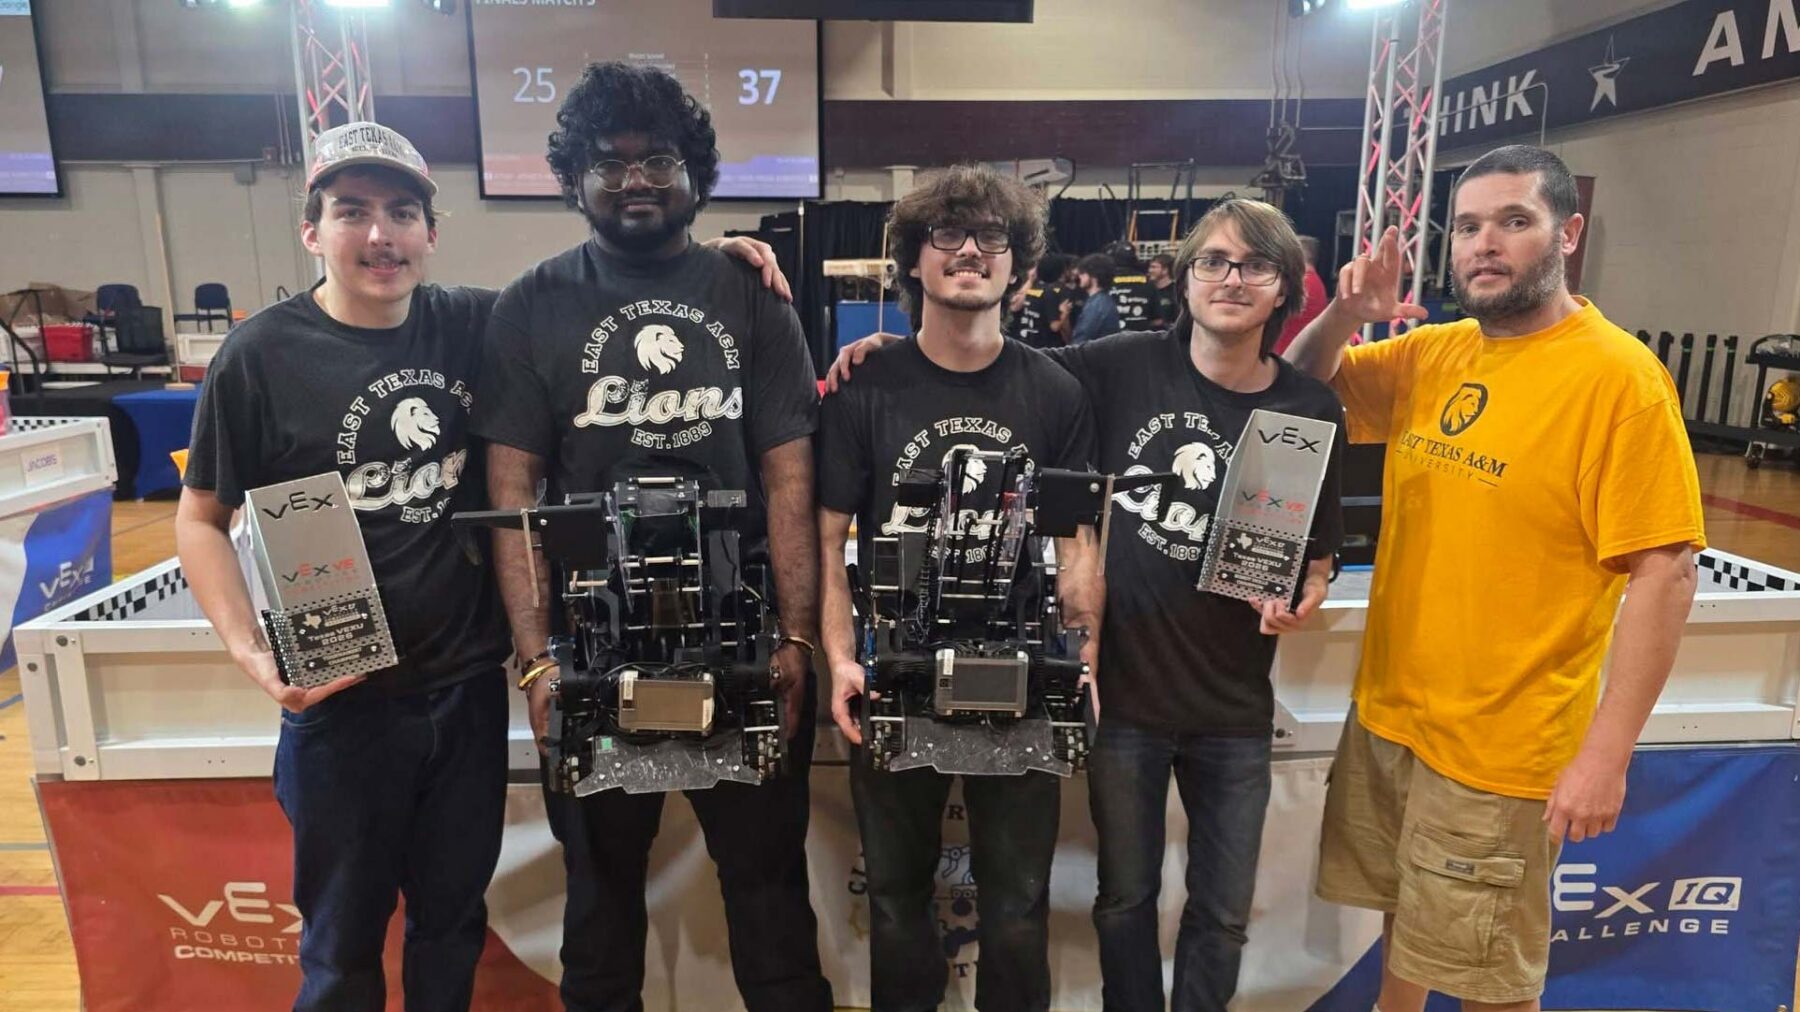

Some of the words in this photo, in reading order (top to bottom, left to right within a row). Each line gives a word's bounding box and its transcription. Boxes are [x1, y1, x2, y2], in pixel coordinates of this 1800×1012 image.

[513, 67, 556, 103] 25
[738, 69, 781, 105] 37
[1436, 69, 1537, 136] HINK
[582, 316, 618, 374] EAST
[620, 300, 705, 323] TEXAS
[706, 321, 741, 370] A&M
[337, 396, 371, 465] EAST
[369, 369, 446, 399] TEXAS
[573, 375, 743, 428] Lions
[630, 421, 713, 449] EST.1889
[934, 417, 1012, 444] TEXAS
[1128, 413, 1176, 460] EAST
[1424, 439, 1464, 462] TEXAS
[1463, 451, 1509, 478] A&M
[1138, 523, 1202, 560] EST.188
[1553, 864, 1661, 919] EX
[1674, 882, 1736, 905] IQ
[169, 927, 300, 950] ROBOT
[1550, 918, 1730, 943] ALLENGE
[174, 945, 300, 965] COMPETI
